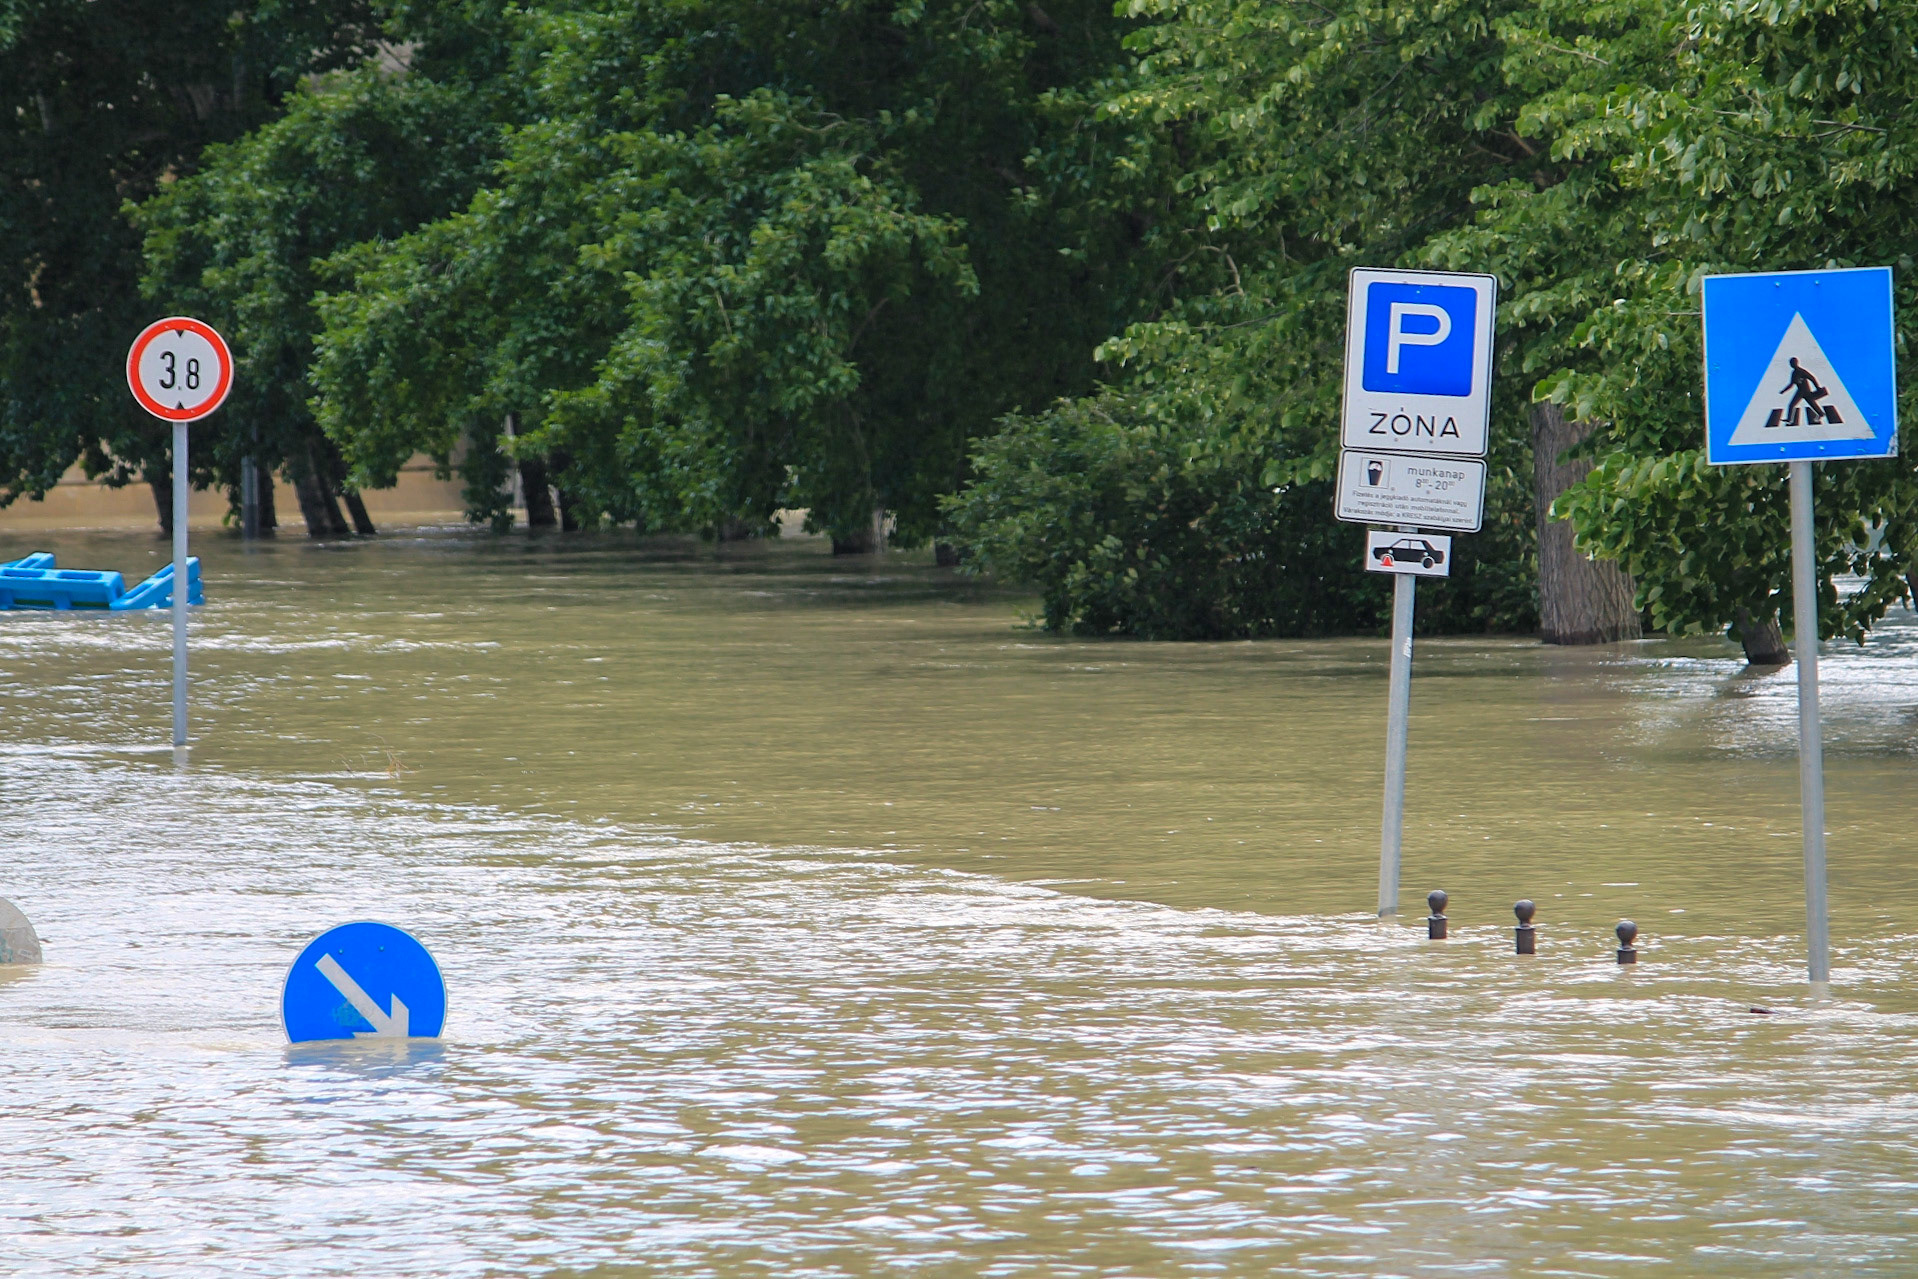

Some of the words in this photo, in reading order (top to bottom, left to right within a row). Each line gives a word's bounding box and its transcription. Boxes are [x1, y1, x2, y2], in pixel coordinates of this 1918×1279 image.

[1386, 302, 1452, 374] P
[159, 351, 200, 390] 3.8
[1368, 407, 1461, 439] ZÓNA
[1407, 467, 1466, 482] munkanap
